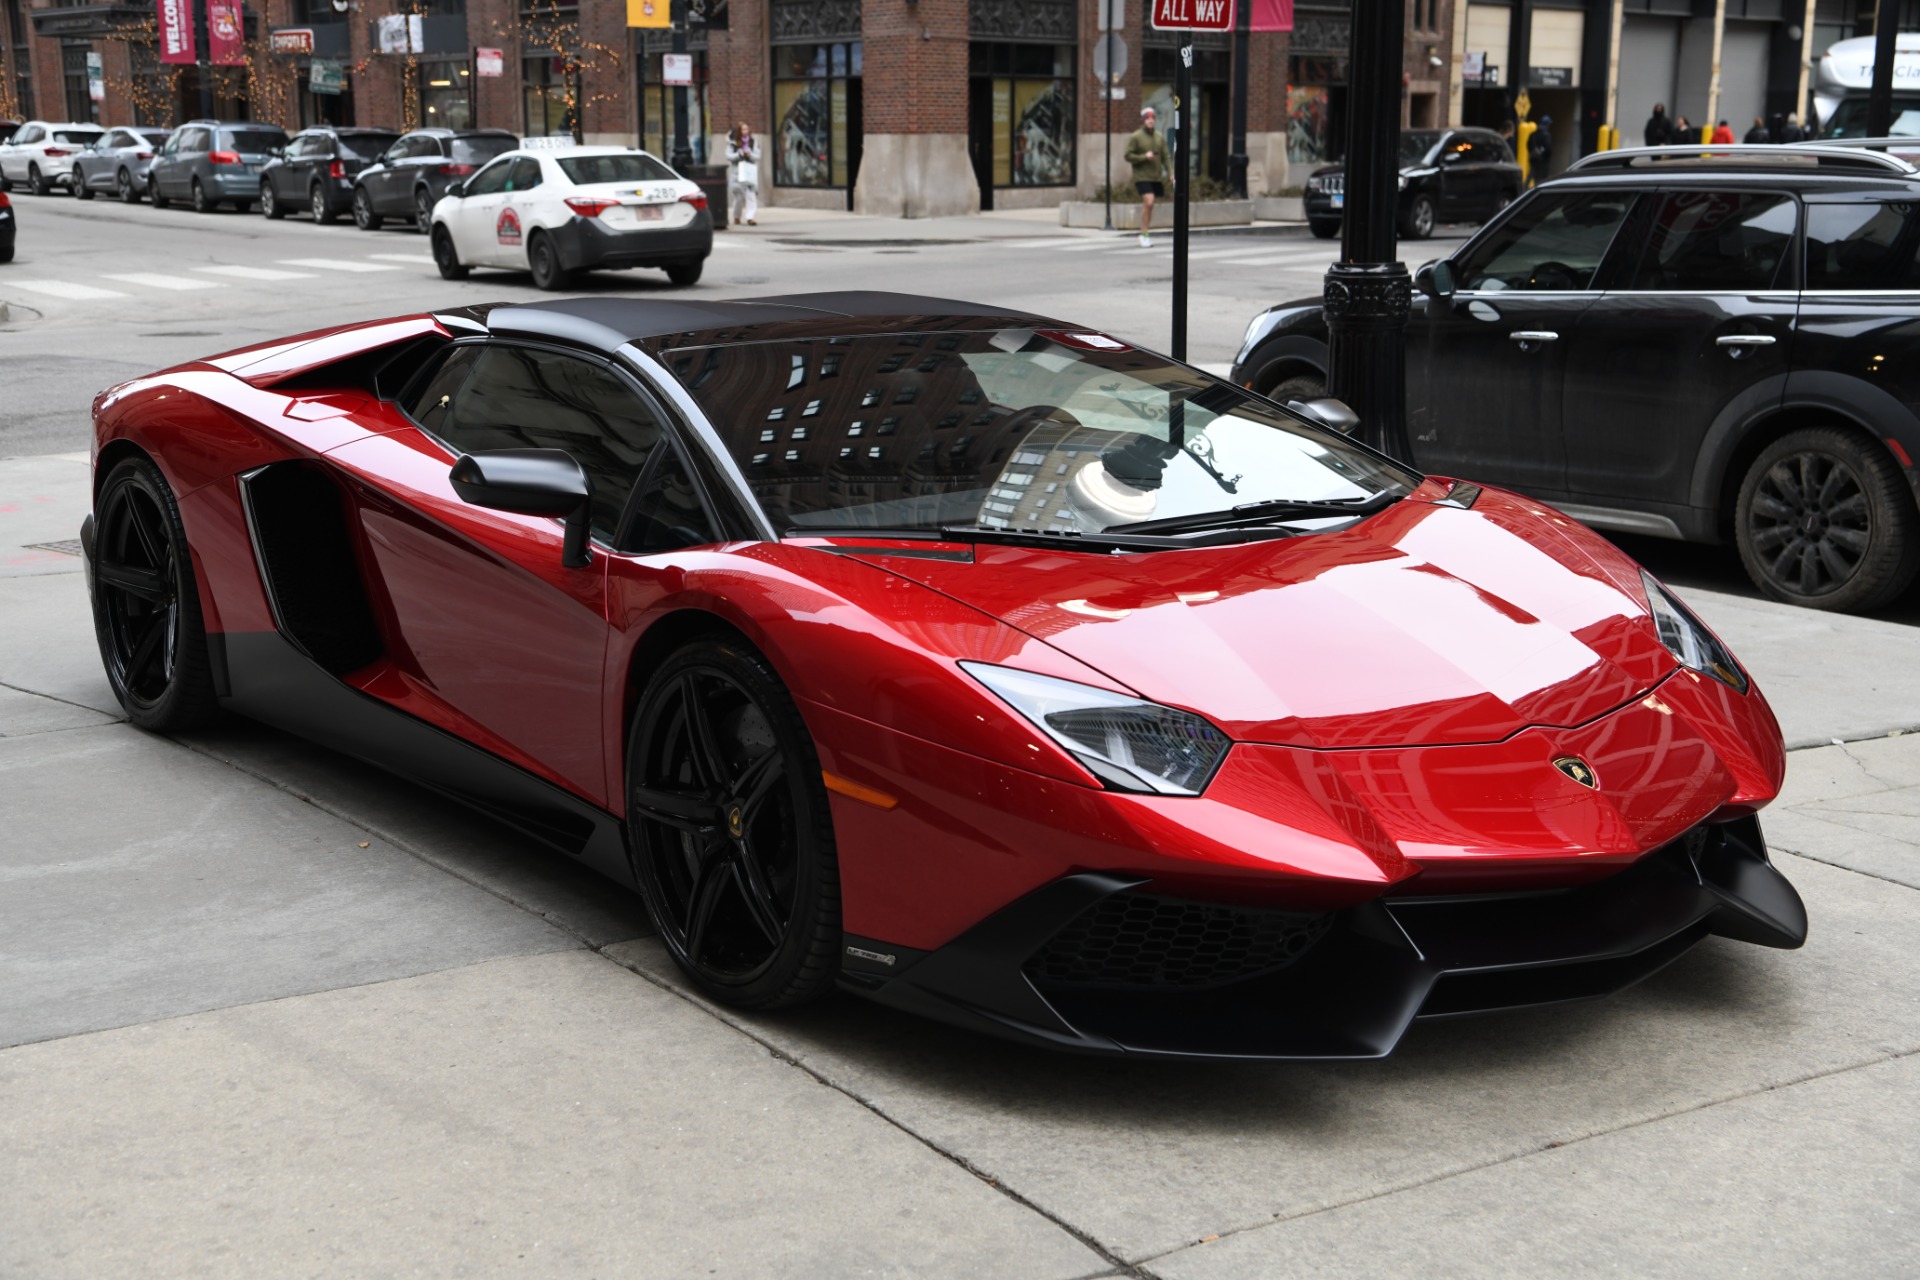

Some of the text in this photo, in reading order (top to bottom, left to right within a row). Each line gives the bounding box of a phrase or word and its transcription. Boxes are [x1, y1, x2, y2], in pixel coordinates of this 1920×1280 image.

[1160, 0, 1225, 22] ALL WAY
[653, 187, 676, 198] 280
